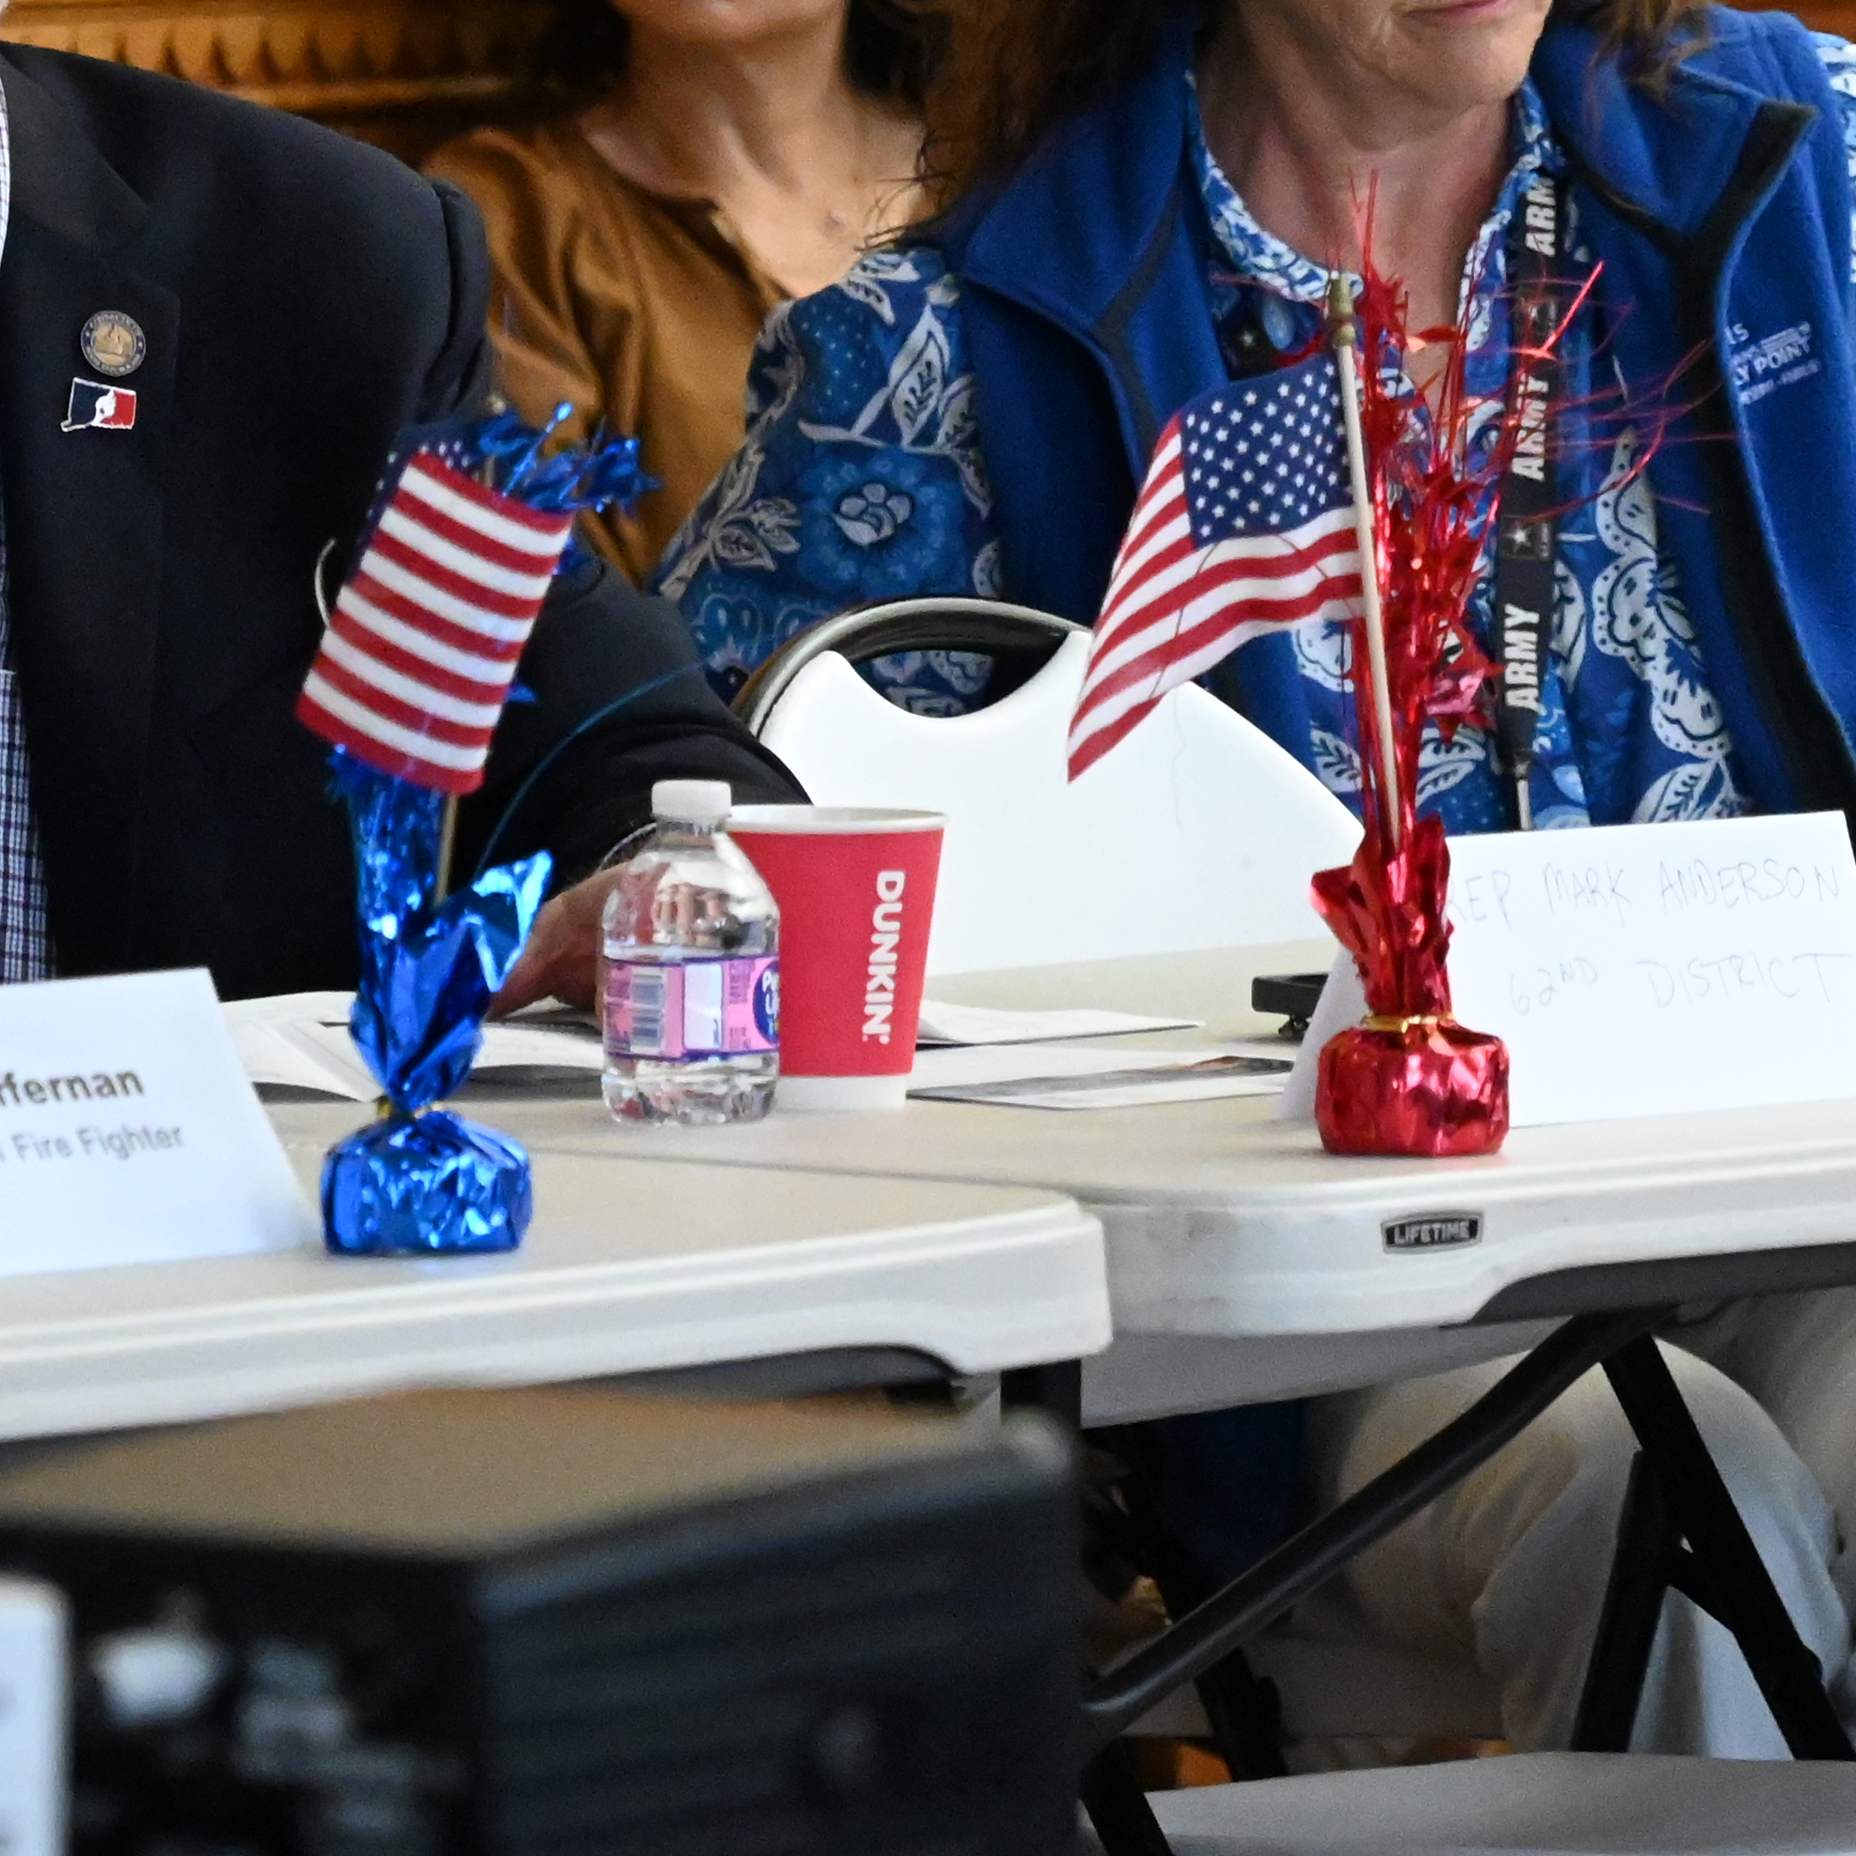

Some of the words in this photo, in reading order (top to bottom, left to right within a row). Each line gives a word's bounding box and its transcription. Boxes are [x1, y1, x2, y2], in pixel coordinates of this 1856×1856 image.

[1525, 175, 1556, 258] ARM
[1511, 372, 1549, 482] ARMY
[1504, 603, 1547, 716] ARMY
[1543, 860, 1633, 929] MARK
[1658, 857, 1840, 915] ANDERSON
[862, 870, 906, 1044] DUNKIN'
[1634, 951, 1853, 1009] DISTRICT
[10, 1130, 75, 1161] Fire
[76, 1123, 186, 1161] Fighter
[1393, 1220, 1471, 1245] LIFETIME
